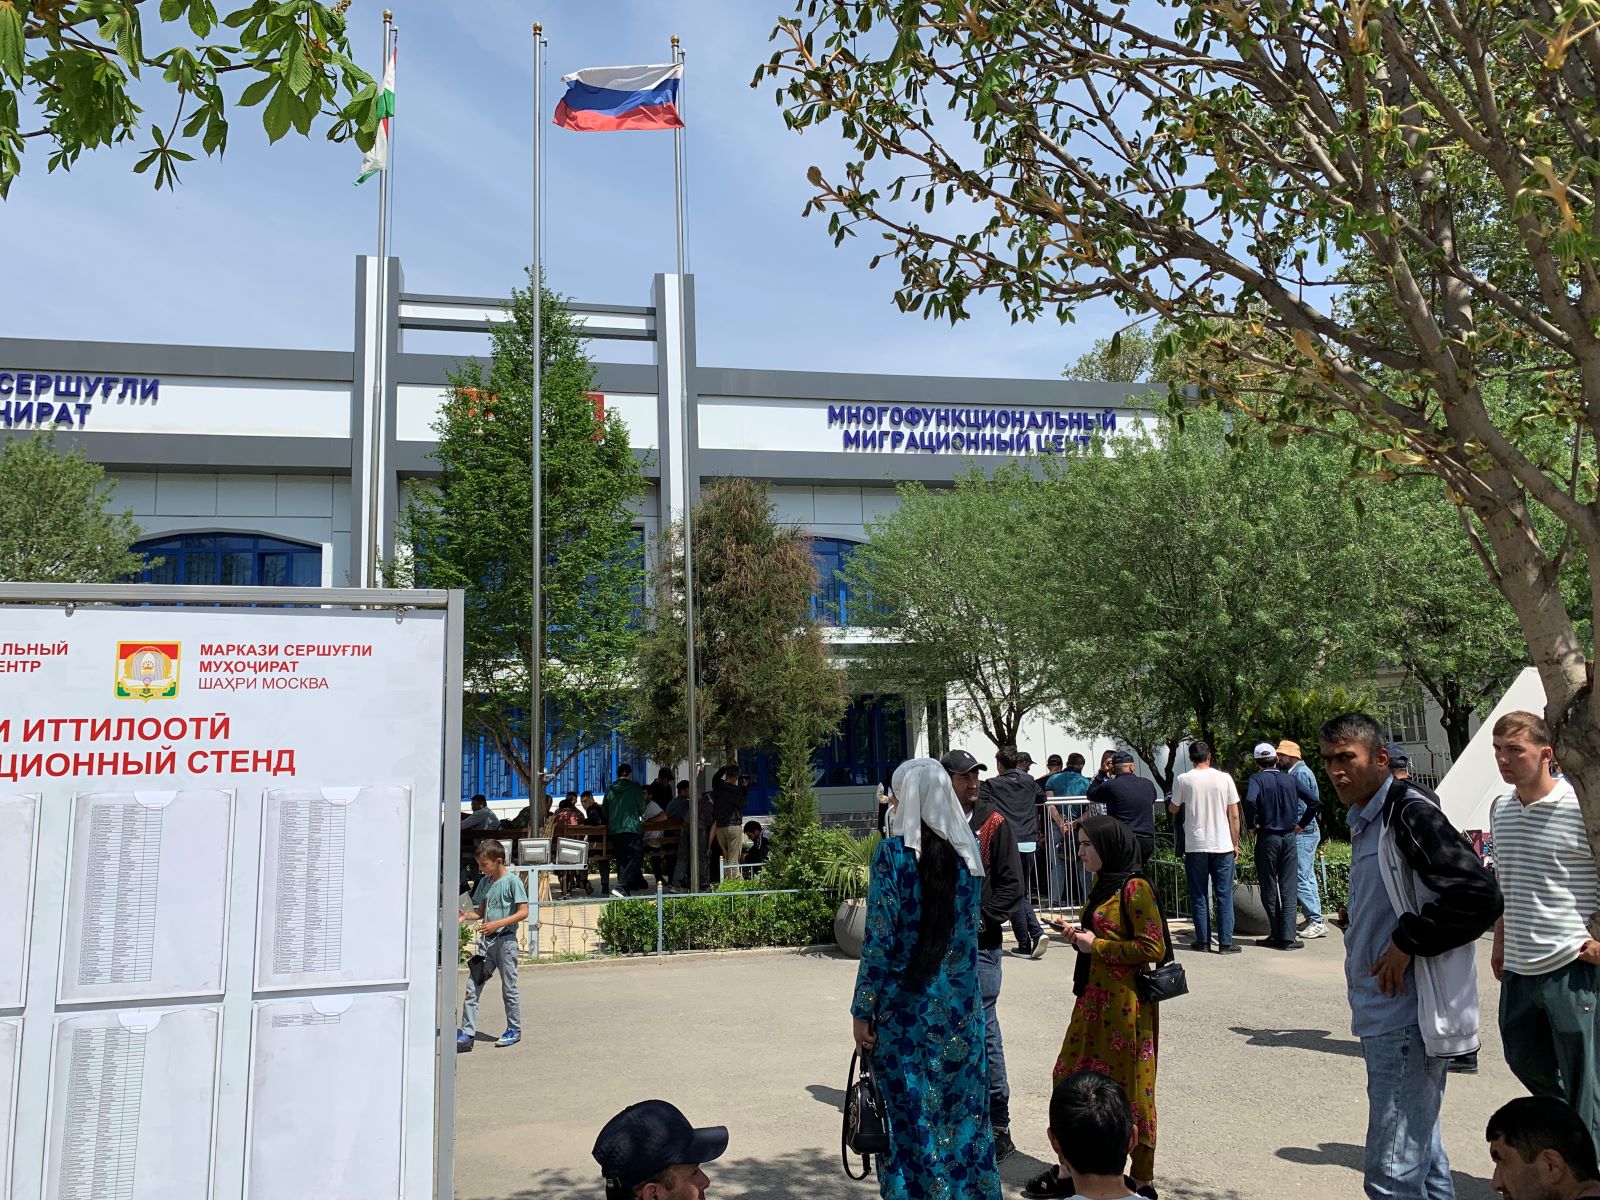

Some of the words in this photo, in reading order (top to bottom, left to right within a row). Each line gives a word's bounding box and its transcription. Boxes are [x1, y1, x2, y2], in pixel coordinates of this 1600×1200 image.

[0, 373, 160, 400] СЕРШУҒЛИ
[828, 405, 1117, 431] МНОГОФУНКЦИОНАЛЬНЫЙ
[843, 430, 1031, 453] МИГРАЦИОННЫЙ
[0, 640, 69, 656] ЛЬНЫЙ
[200, 644, 279, 656] МАРКАЗИ
[284, 644, 372, 656] СЕРШУҒЛИ
[199, 661, 299, 674] МУҲОҶИРАТ
[198, 677, 257, 692] ШАҲРИ
[262, 677, 329, 690] МОСКВА
[23, 712, 230, 742] ИТТИЛООТӢ
[0, 746, 176, 782] ЦИОННЫЙ
[187, 749, 296, 776] СТЕНД
